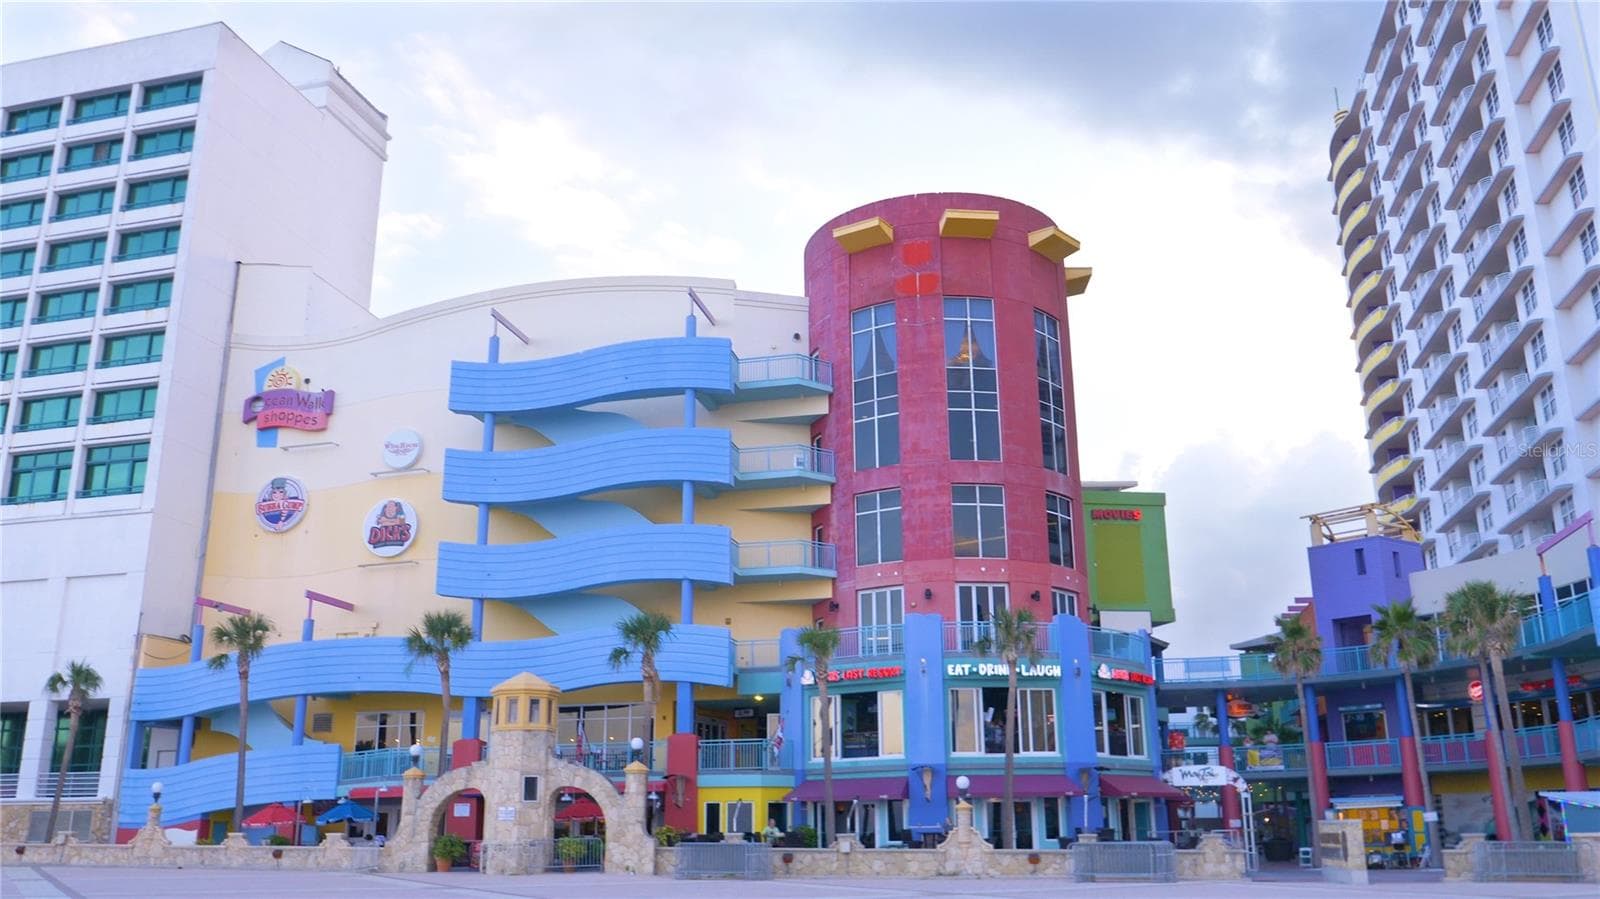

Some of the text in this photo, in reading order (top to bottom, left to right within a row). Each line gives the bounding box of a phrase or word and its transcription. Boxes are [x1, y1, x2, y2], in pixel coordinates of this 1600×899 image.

[296, 392, 325, 409] Walk
[264, 410, 318, 426] shoppes
[1092, 508, 1143, 521] MOVIES
[368, 523, 411, 545] DICK'S
[843, 669, 864, 681] LAST
[947, 664, 971, 676] EAT
[1021, 664, 1061, 677] LAUGH
